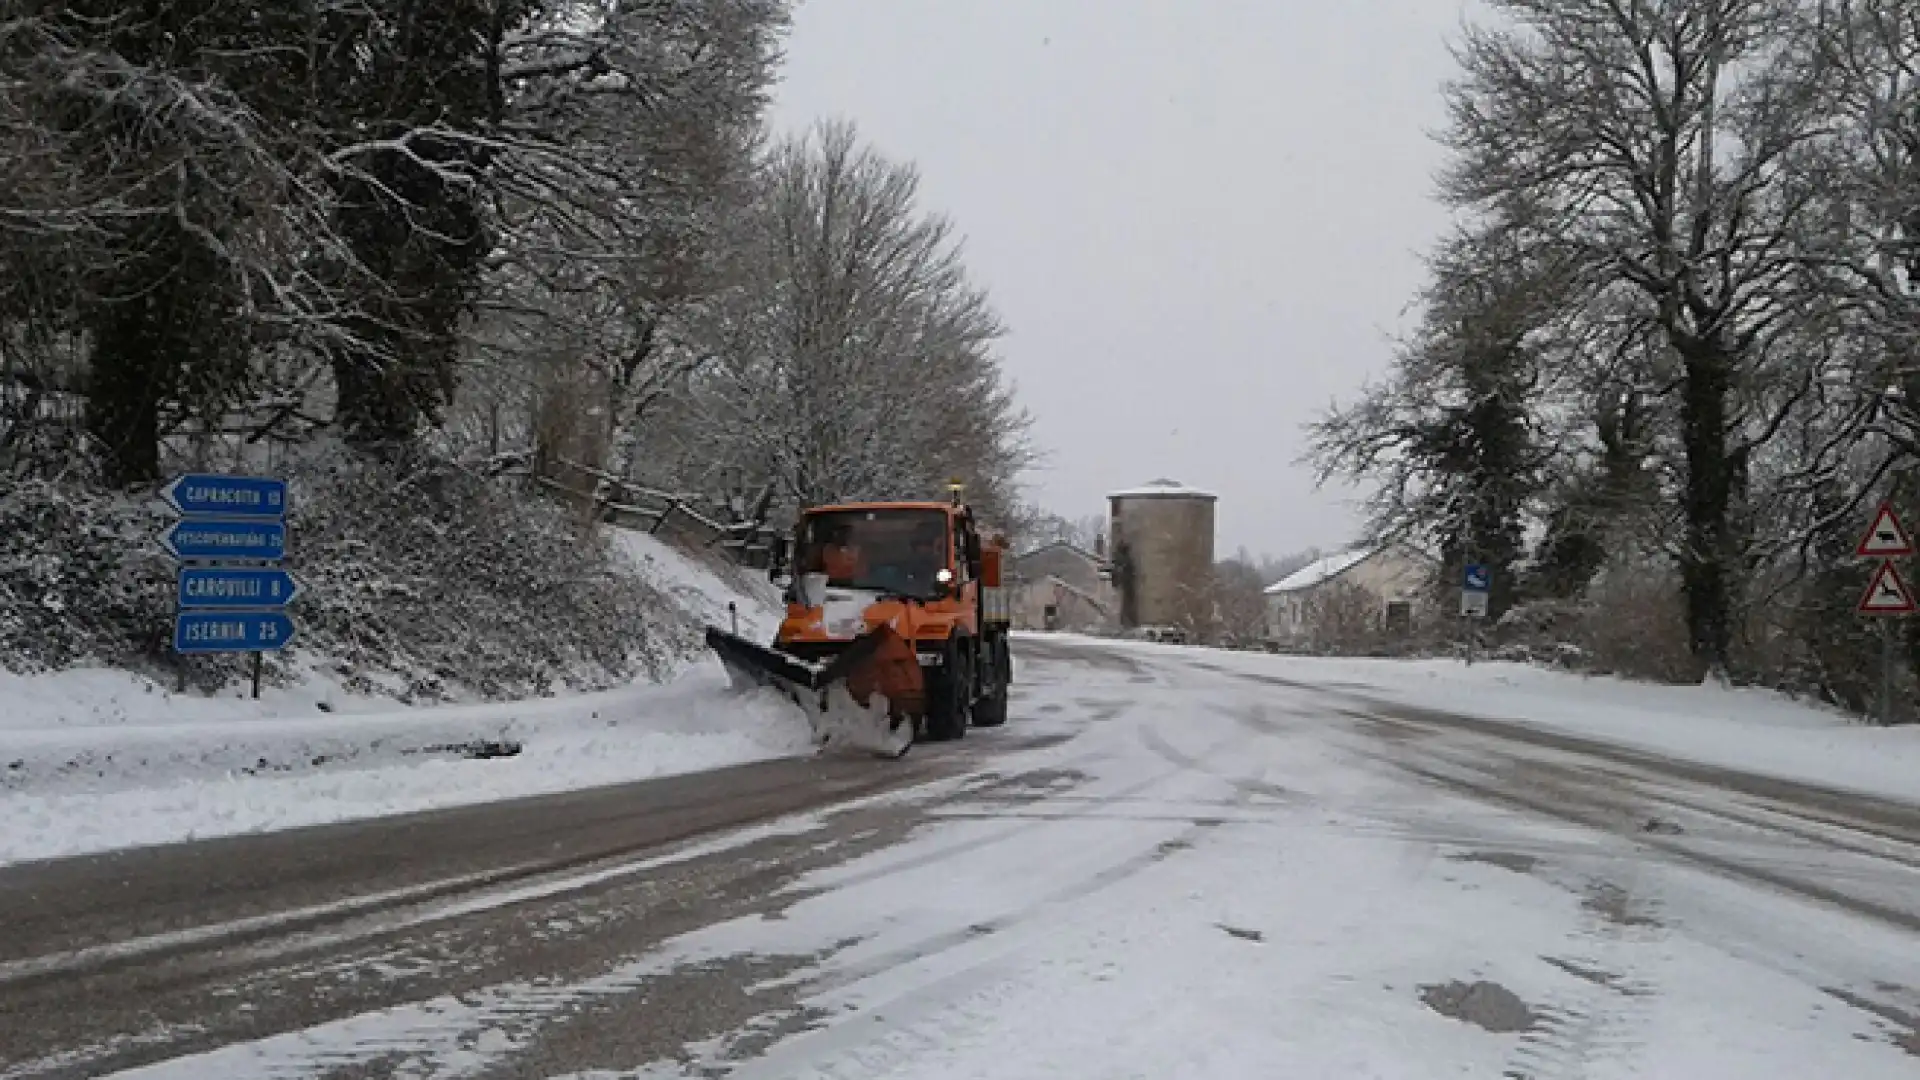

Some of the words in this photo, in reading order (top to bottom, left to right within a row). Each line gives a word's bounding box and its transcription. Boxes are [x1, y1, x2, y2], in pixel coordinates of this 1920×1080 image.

[185, 577, 261, 597] CAROVILLI
[185, 621, 246, 640] ISERNIA
[259, 621, 279, 640] 25
